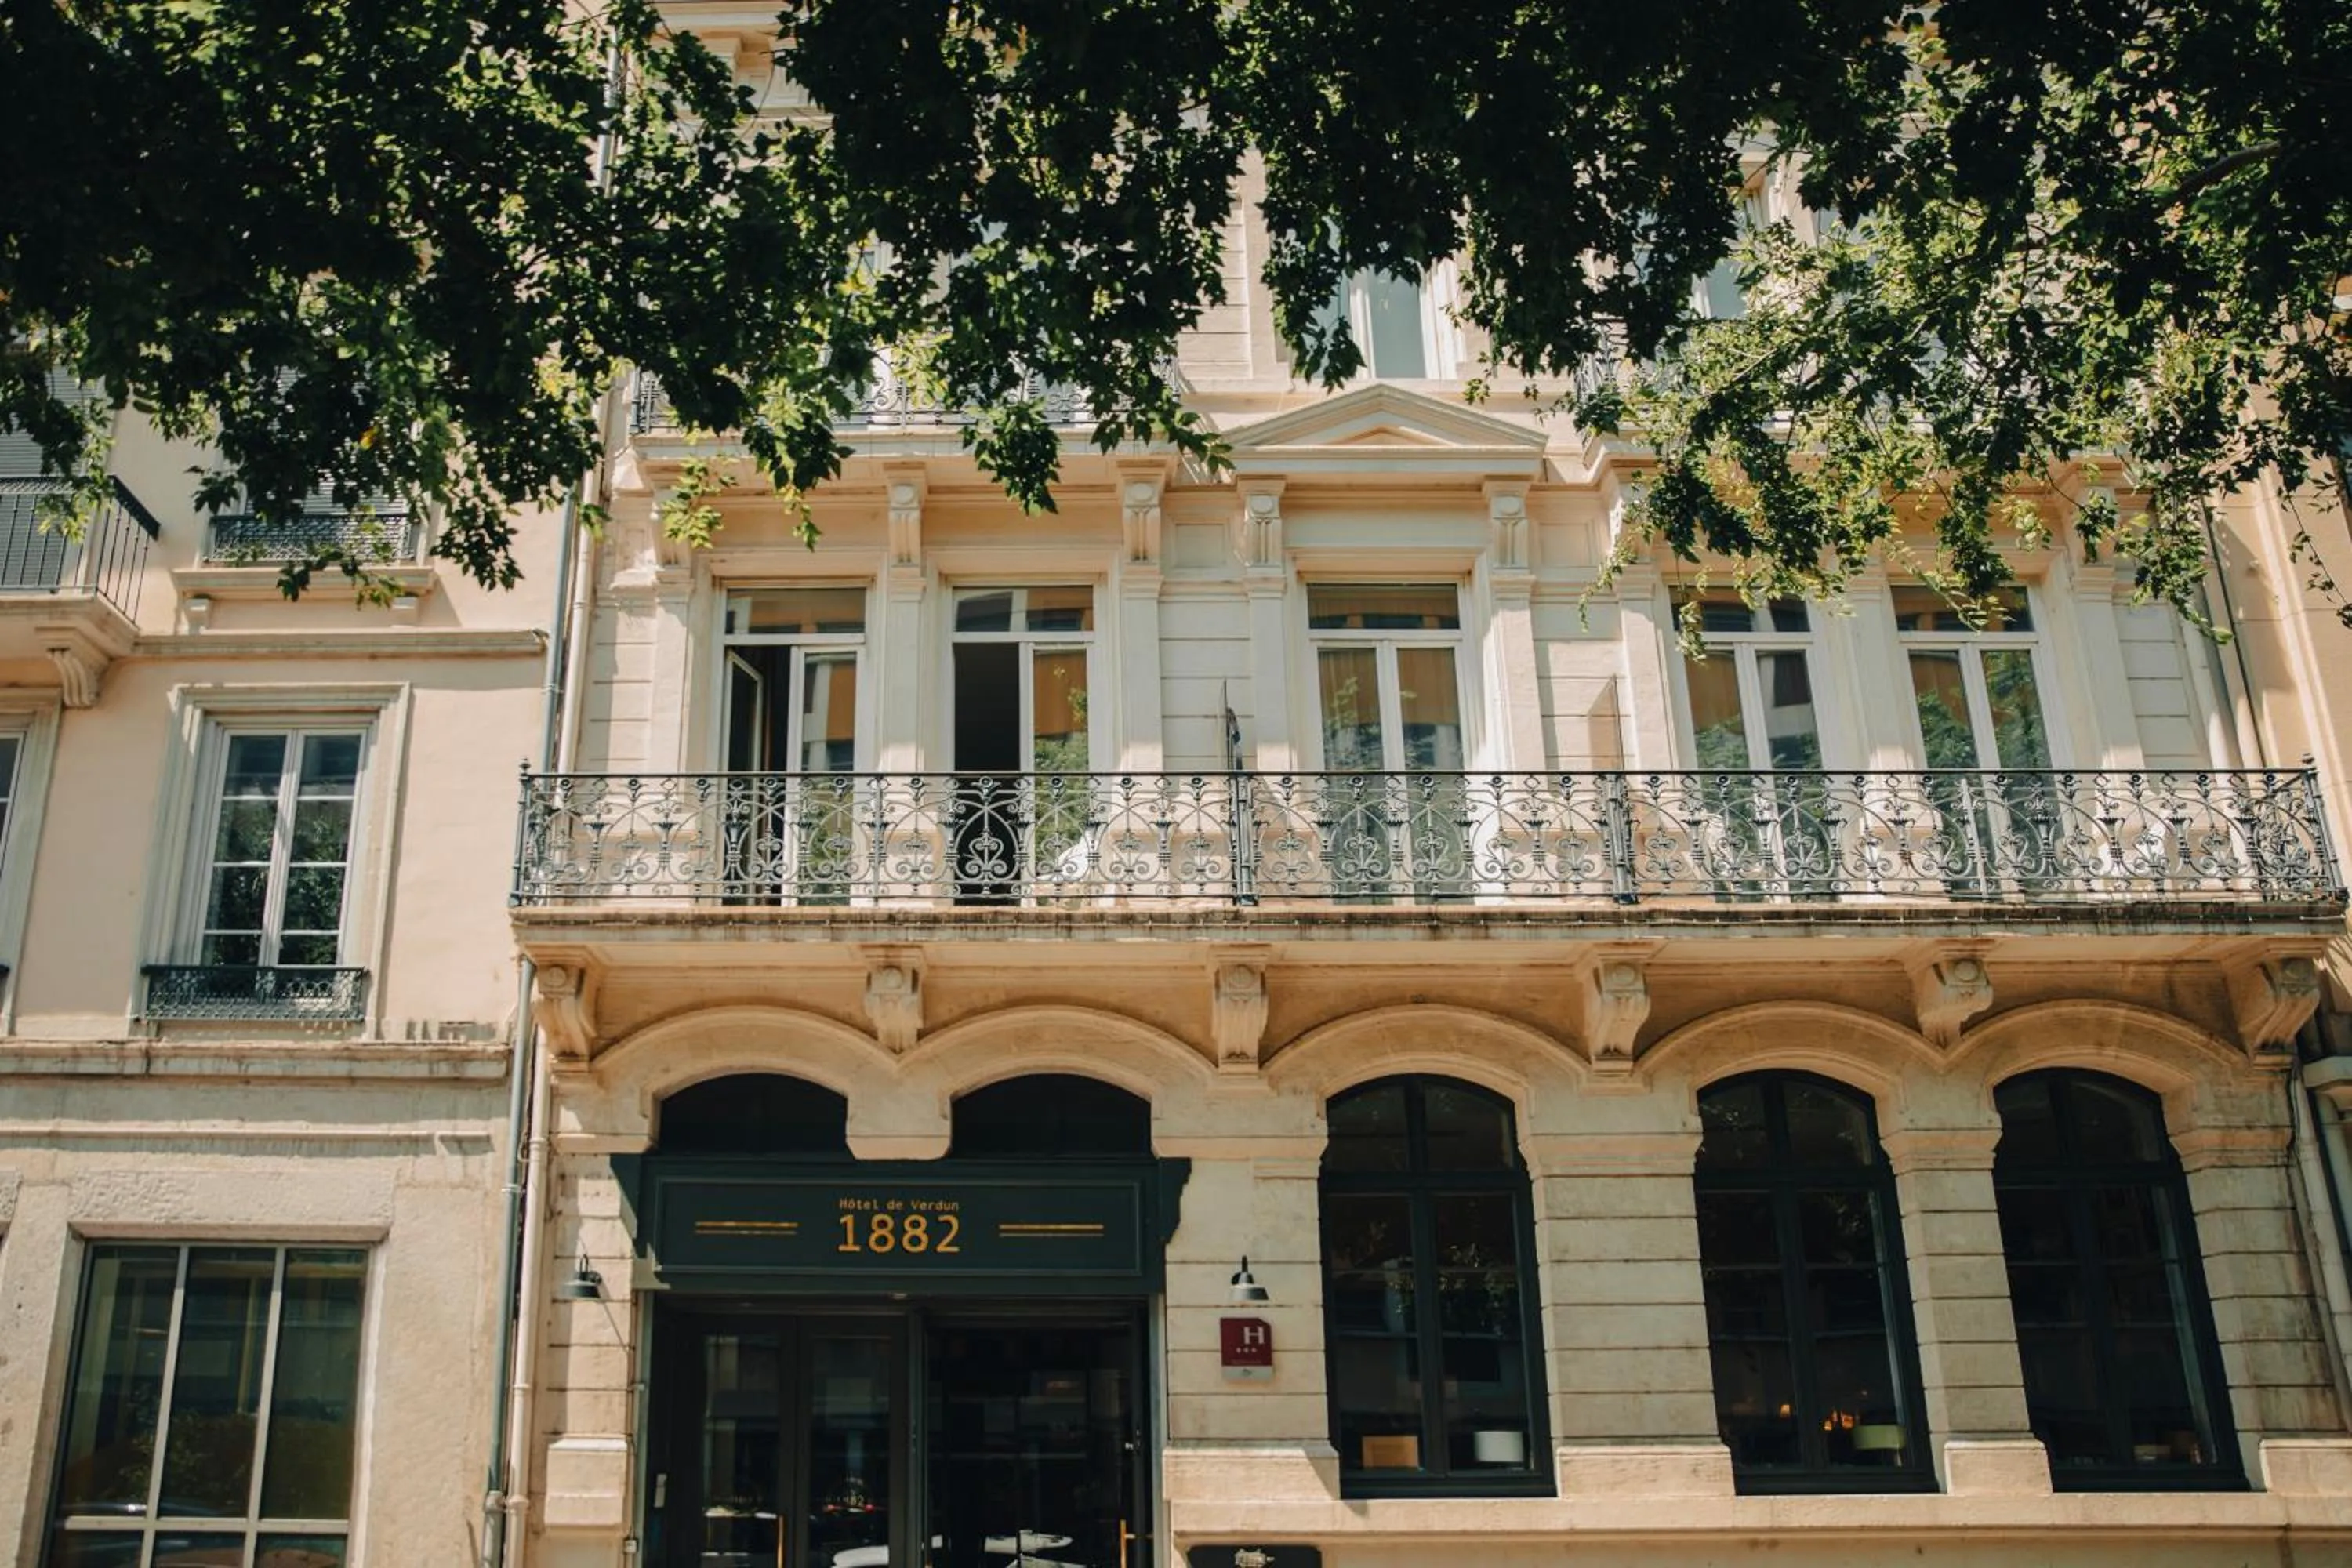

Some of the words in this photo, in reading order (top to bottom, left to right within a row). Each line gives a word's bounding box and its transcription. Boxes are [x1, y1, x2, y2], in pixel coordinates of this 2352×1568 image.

[839, 1198, 879, 1210] Hôtel
[887, 1200, 904, 1210] de
[910, 1200, 959, 1212] Verdun
[838, 1213, 960, 1253] 1882
[1243, 1326, 1265, 1345] H
